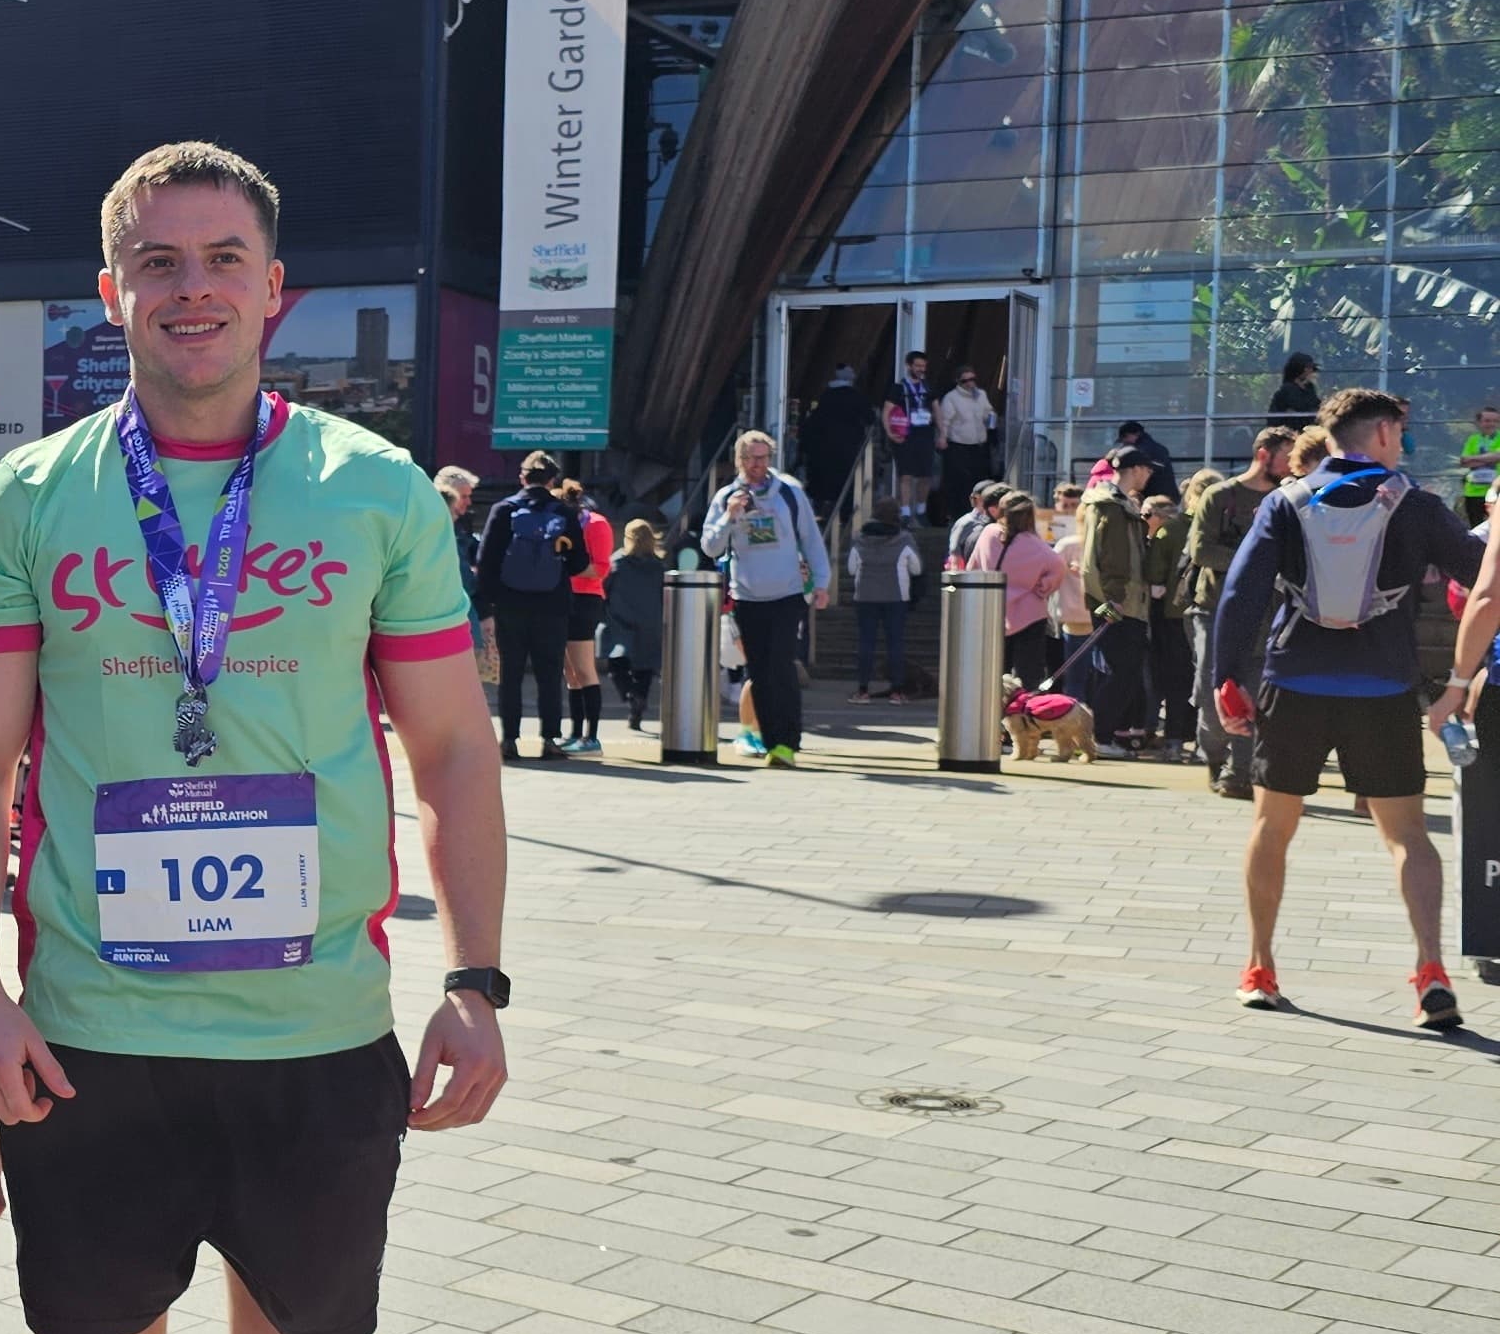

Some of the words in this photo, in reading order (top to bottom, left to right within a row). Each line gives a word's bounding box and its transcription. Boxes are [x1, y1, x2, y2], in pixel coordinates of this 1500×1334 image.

[544, 104, 582, 229] Winter
[532, 243, 587, 257] Sheffield
[532, 314, 566, 323] Access
[518, 334, 557, 343] Sheffield
[541, 349, 585, 359] Sandwich
[77, 357, 129, 373] Sheffi
[92, 394, 122, 406] .co
[131, 430, 146, 451] FOR
[138, 450, 152, 475] RUN
[228, 475, 242, 500] RUN
[223, 500, 237, 522] FOR
[218, 523, 232, 542] ALL
[216, 546, 232, 578] 2024
[51, 546, 135, 633] St
[144, 524, 348, 607] ke's
[183, 780, 217, 790] Sheffield
[183, 788, 213, 798] Mutual
[169, 800, 225, 812] SHEFFIELD
[169, 813, 199, 824] HALF
[200, 810, 268, 822] MARATHON
[107, 876, 115, 892] L
[160, 853, 265, 903] 102
[300, 888, 308, 907] LIAM
[188, 917, 233, 933] LIAM
[112, 953, 134, 962] RUN
[134, 953, 153, 962] FOR
[154, 953, 171, 963] ALL
